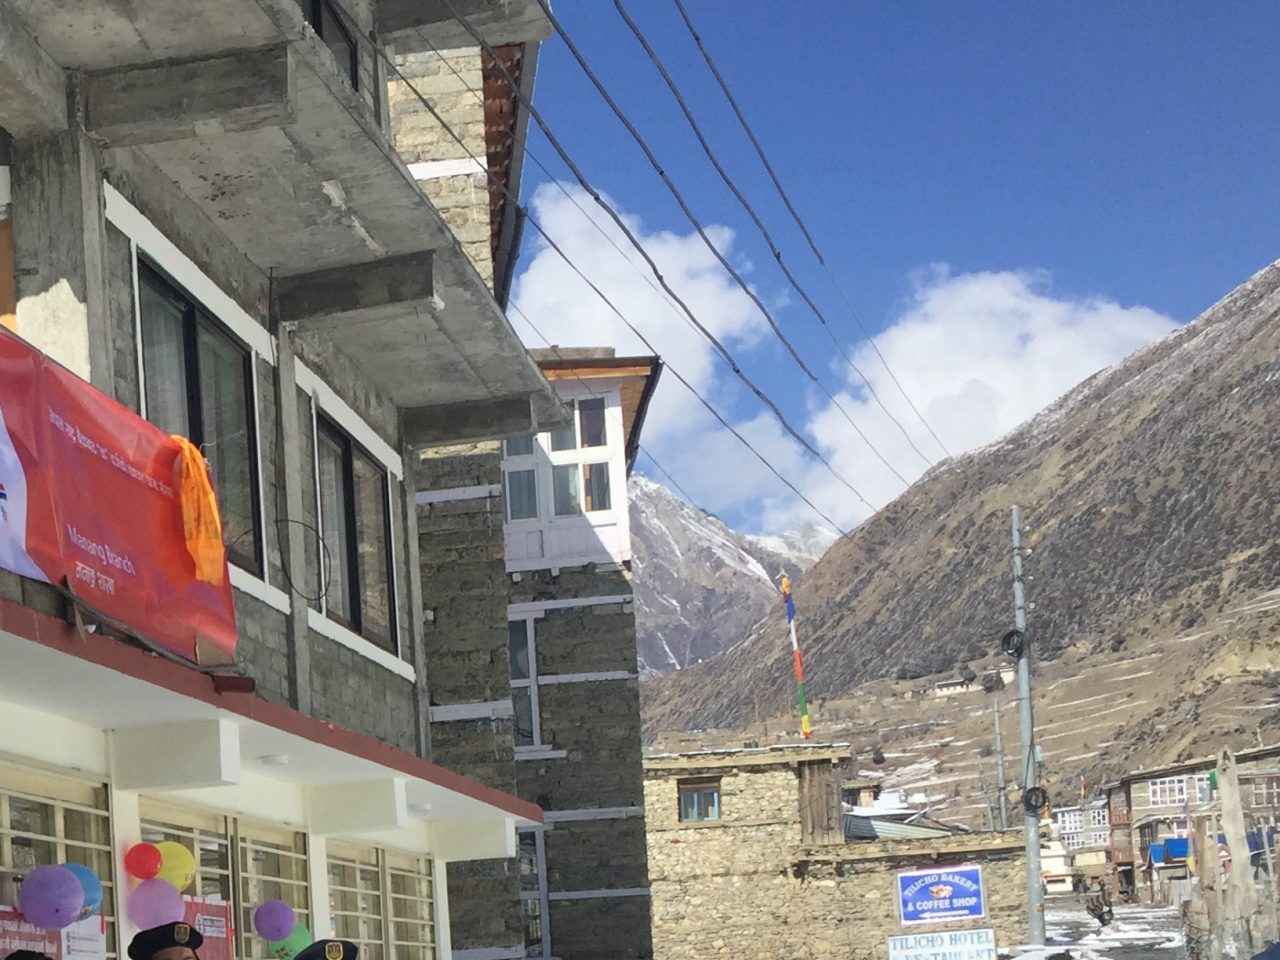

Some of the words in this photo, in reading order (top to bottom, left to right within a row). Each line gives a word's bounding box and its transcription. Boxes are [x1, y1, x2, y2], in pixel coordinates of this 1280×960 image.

[903, 874, 939, 897] TILICHO
[941, 873, 978, 892] BAKERY
[907, 902, 914, 911] &
[916, 899, 951, 911] COFFEE
[952, 897, 977, 908] SHOP
[890, 935, 944, 951] TILICHO
[949, 931, 993, 947] HOTEL
